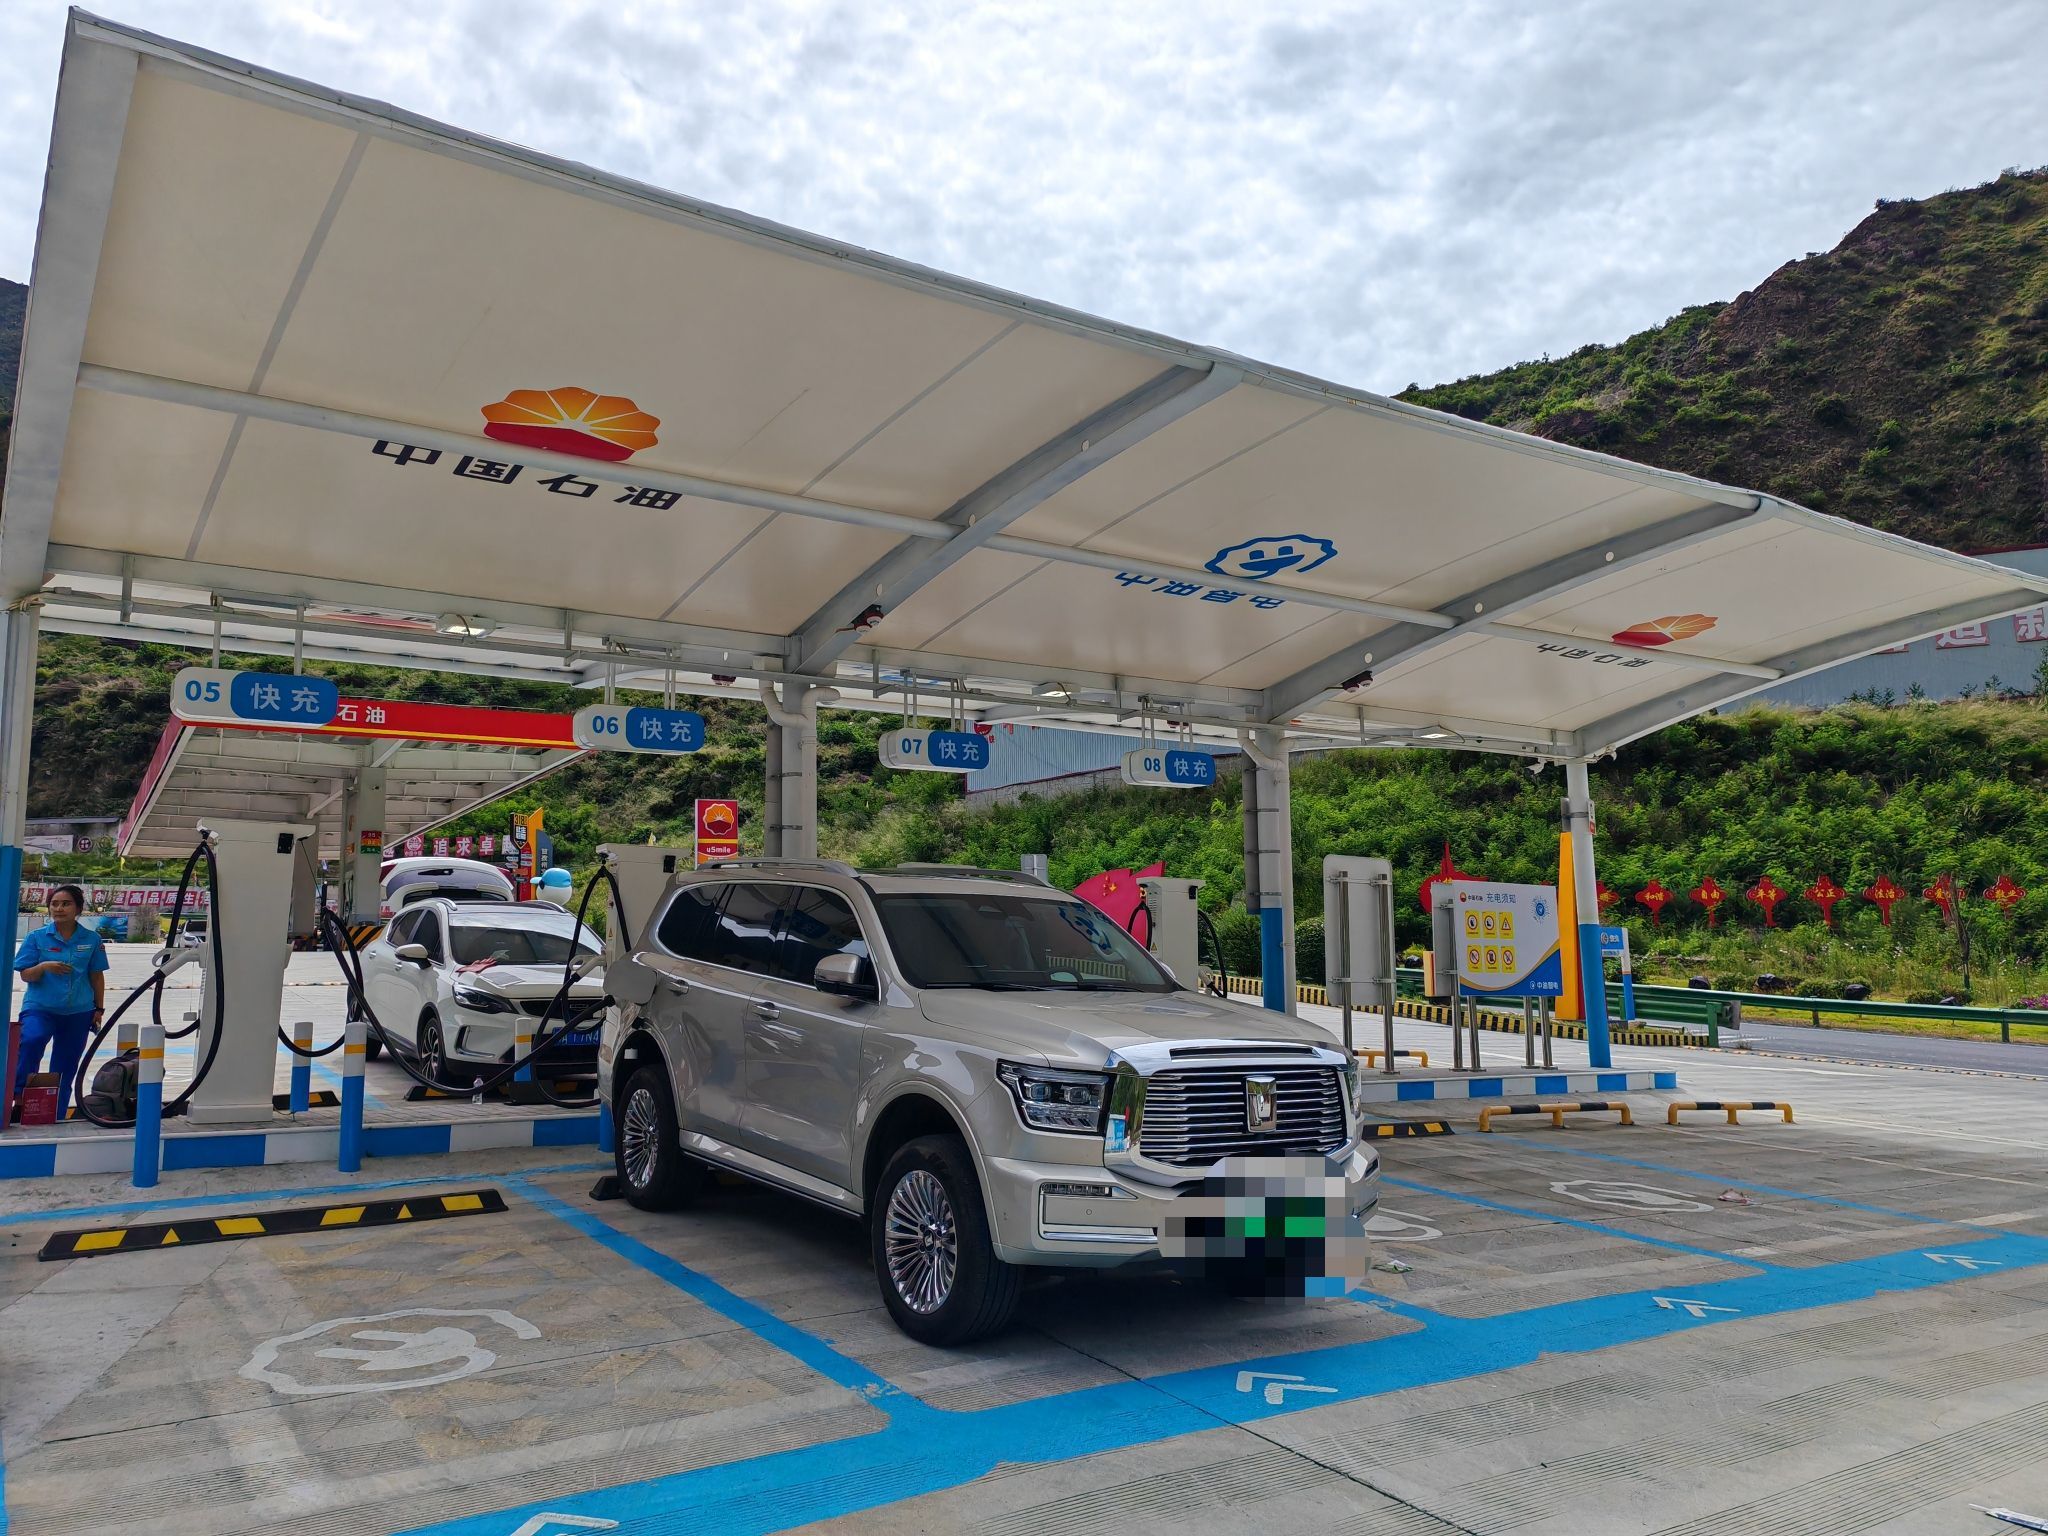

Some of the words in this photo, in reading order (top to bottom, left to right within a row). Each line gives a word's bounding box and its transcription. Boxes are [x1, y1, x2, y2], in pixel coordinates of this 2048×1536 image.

[371, 439, 683, 511] 中国石油
[185, 680, 221, 703] 05
[250, 682, 320, 713] 快充
[337, 703, 386, 724] 石油
[592, 715, 619, 735] 06
[640, 716, 692, 743] 快充
[901, 738, 922, 755] 07
[938, 738, 980, 761] 快充
[1143, 757, 1161, 772] 08
[1173, 757, 1208, 778] 快充
[706, 846, 731, 854] uSmile
[1486, 892, 1517, 904] 充电须知
